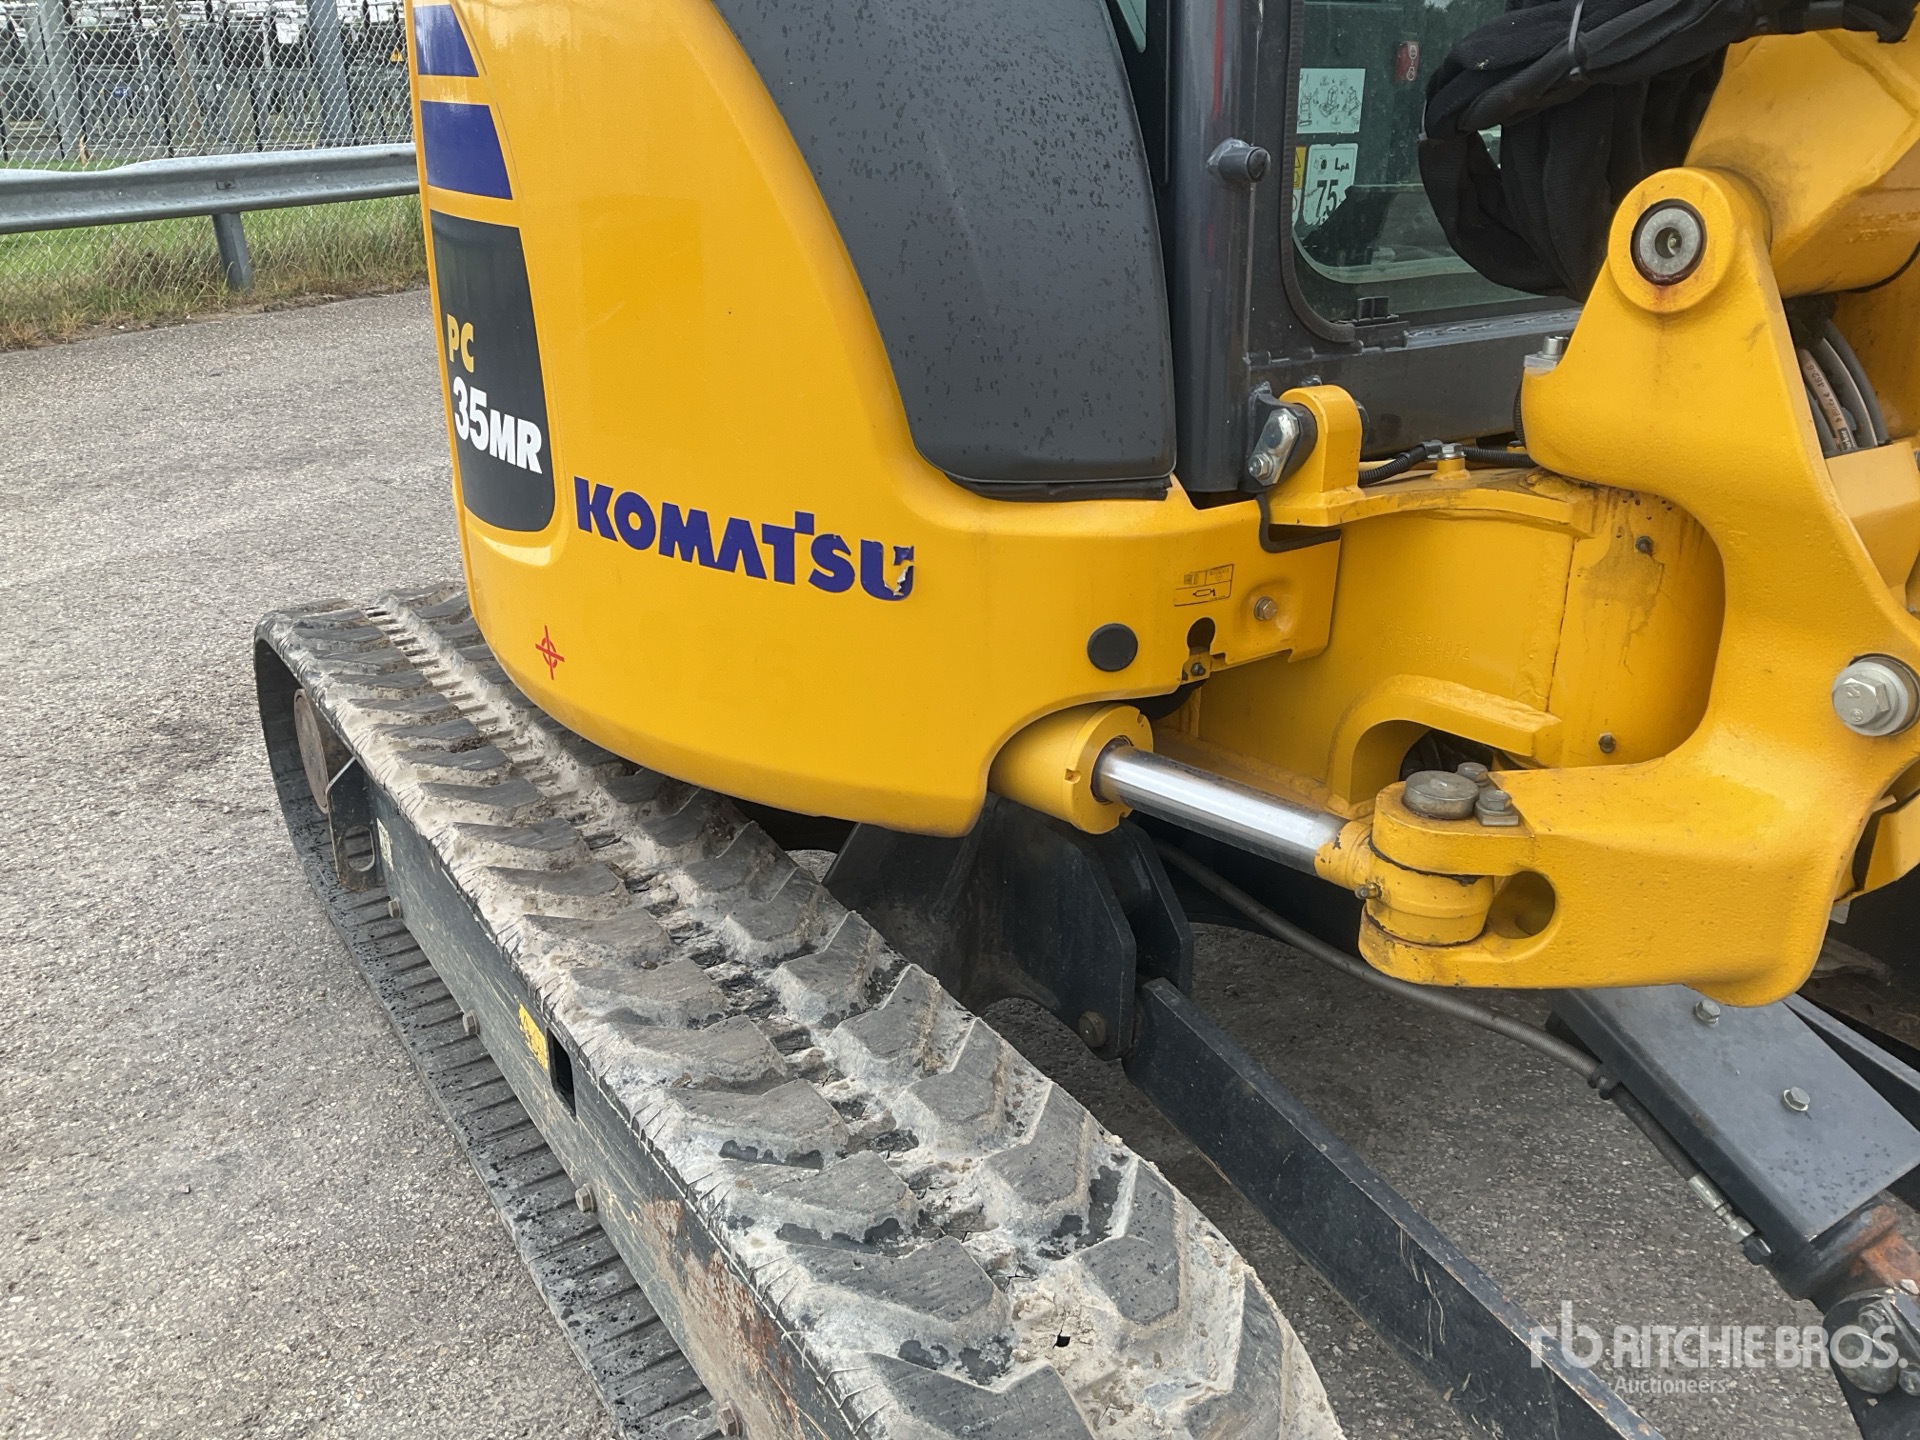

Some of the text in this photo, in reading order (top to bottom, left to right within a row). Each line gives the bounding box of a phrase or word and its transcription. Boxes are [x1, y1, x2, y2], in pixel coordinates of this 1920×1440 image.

[1316, 179, 1338, 218] 75
[447, 314, 474, 373] PC
[453, 376, 543, 474] 35MR
[573, 476, 915, 601] KOMATSU
